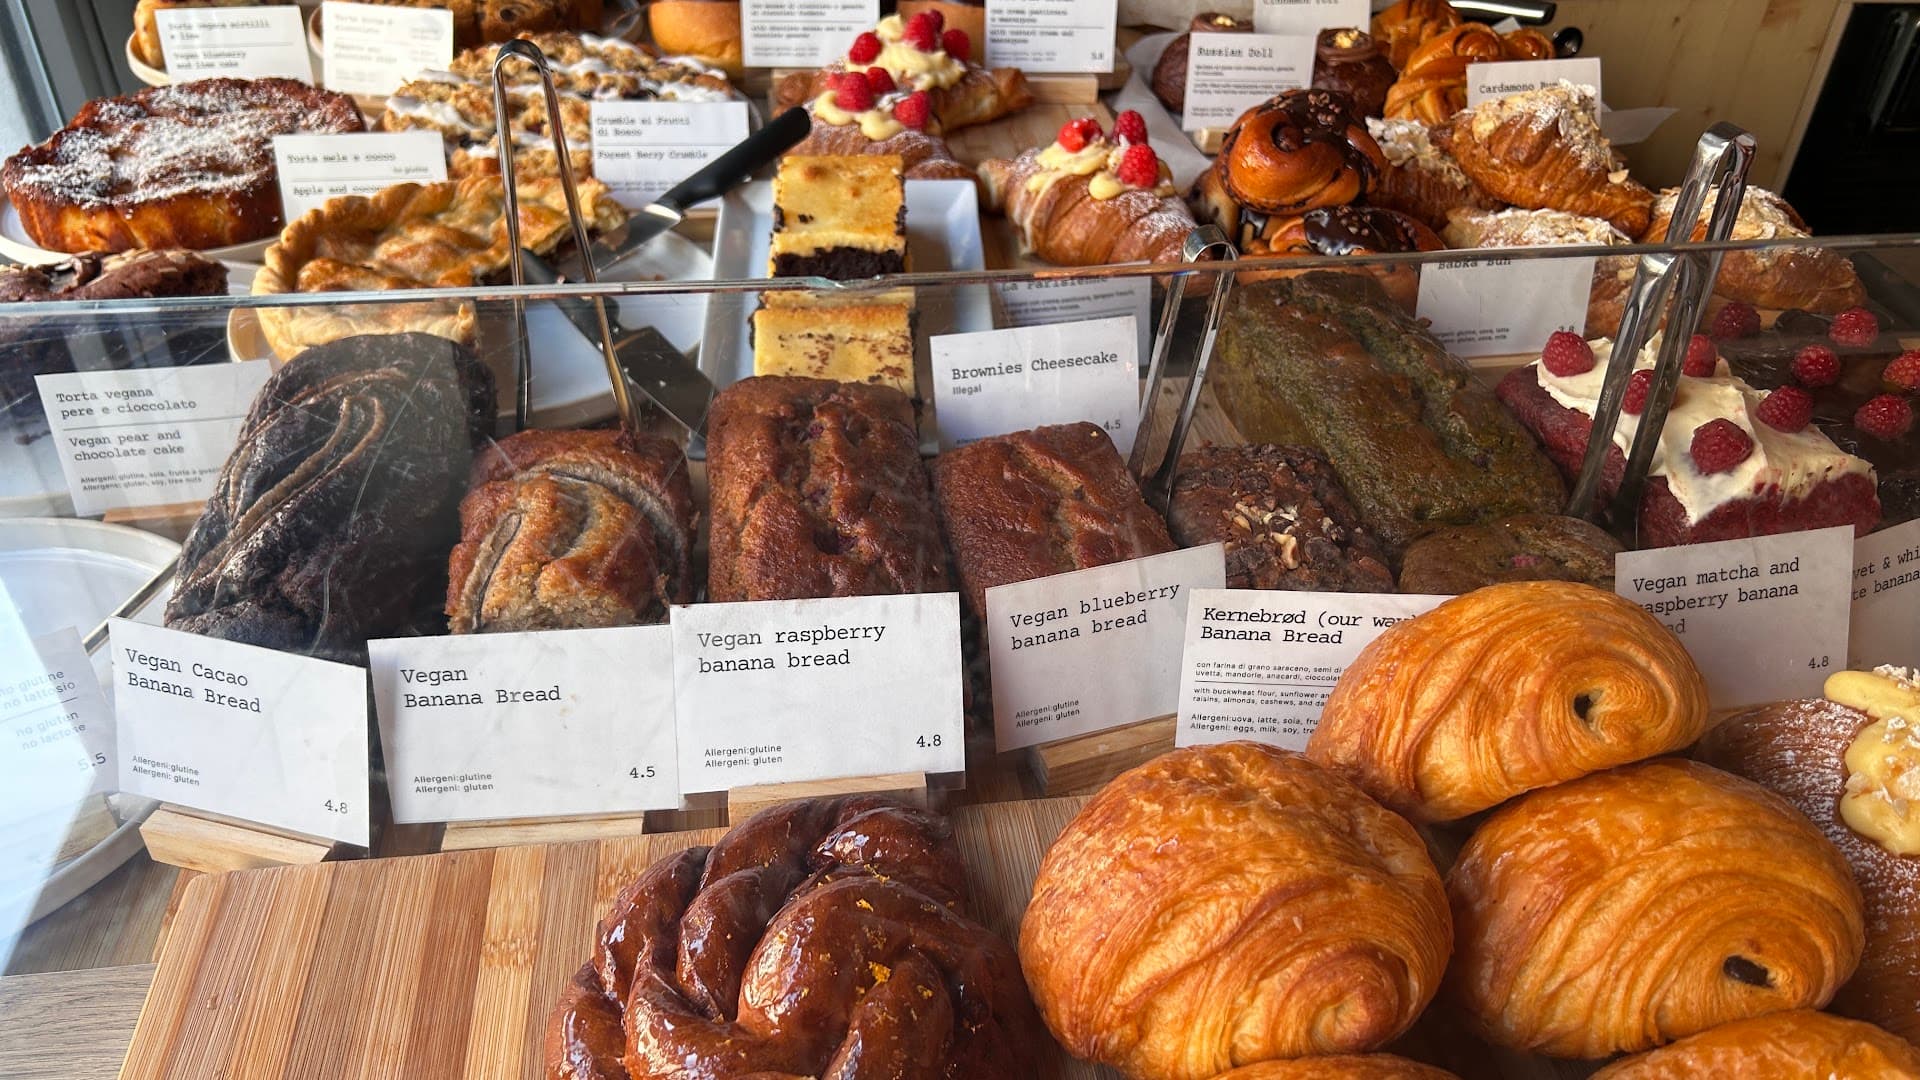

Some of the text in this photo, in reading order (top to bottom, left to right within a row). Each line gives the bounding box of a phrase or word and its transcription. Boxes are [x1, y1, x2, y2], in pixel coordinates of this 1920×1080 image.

[1197, 47, 1273, 58] Russian Doll
[952, 351, 1118, 380] Brownies Cheesecake
[56, 387, 154, 402] Torta vegana
[953, 384, 982, 395] Illegal
[61, 399, 197, 420] pere e cioccolato
[1103, 419, 1121, 431] 4.5
[68, 429, 182, 449] Vegan pear and
[74, 444, 184, 462] chocolate cake
[1852, 545, 1920, 579] vet & whi
[1633, 556, 1800, 594] Vegan matcha and
[1851, 568, 1920, 601] te banana
[1010, 584, 1181, 628] Vegan blueberry
[1639, 583, 1799, 617] aspberry banana
[1203, 607, 1307, 625] Kernebrød
[1318, 610, 1363, 628] (our
[697, 624, 886, 651] Vegan raspberry
[1011, 609, 1149, 651] banana bread
[1200, 626, 1344, 645] Banana Bread
[125, 648, 248, 687] Vegan Cacao
[699, 648, 851, 673] banana bread
[1213, 661, 1236, 670] farina
[1247, 664, 1271, 672] grano
[1273, 664, 1311, 673] saraceno,
[1313, 665, 1332, 673] semi
[1807, 655, 1829, 670] 4.8
[401, 667, 468, 685] Vegan
[1304, 673, 1340, 682] cioccolat
[127, 671, 262, 713] Banana Bread
[404, 685, 562, 708] Banana Bread
[1192, 695, 1221, 703] raisins,
[1260, 698, 1296, 706] cashews,
[1298, 698, 1313, 706] and
[1314, 699, 1325, 707] da
[1212, 688, 1255, 696] buckwheat
[1257, 689, 1278, 697] flour,
[1280, 690, 1318, 698] sunflower
[1055, 709, 1080, 721] gluten
[1257, 715, 1280, 725] latte,
[1306, 717, 1318, 726] fru
[1190, 722, 1315, 735] Allergeni: eggs, milk, soy, tre
[916, 734, 942, 748] 4.8
[705, 756, 783, 768] Allergeni: gluten
[133, 765, 200, 786] Allergeni: gluten
[629, 766, 655, 779] 4.5
[415, 783, 494, 793] Allergeni: gluten
[324, 799, 349, 815] 4.8
